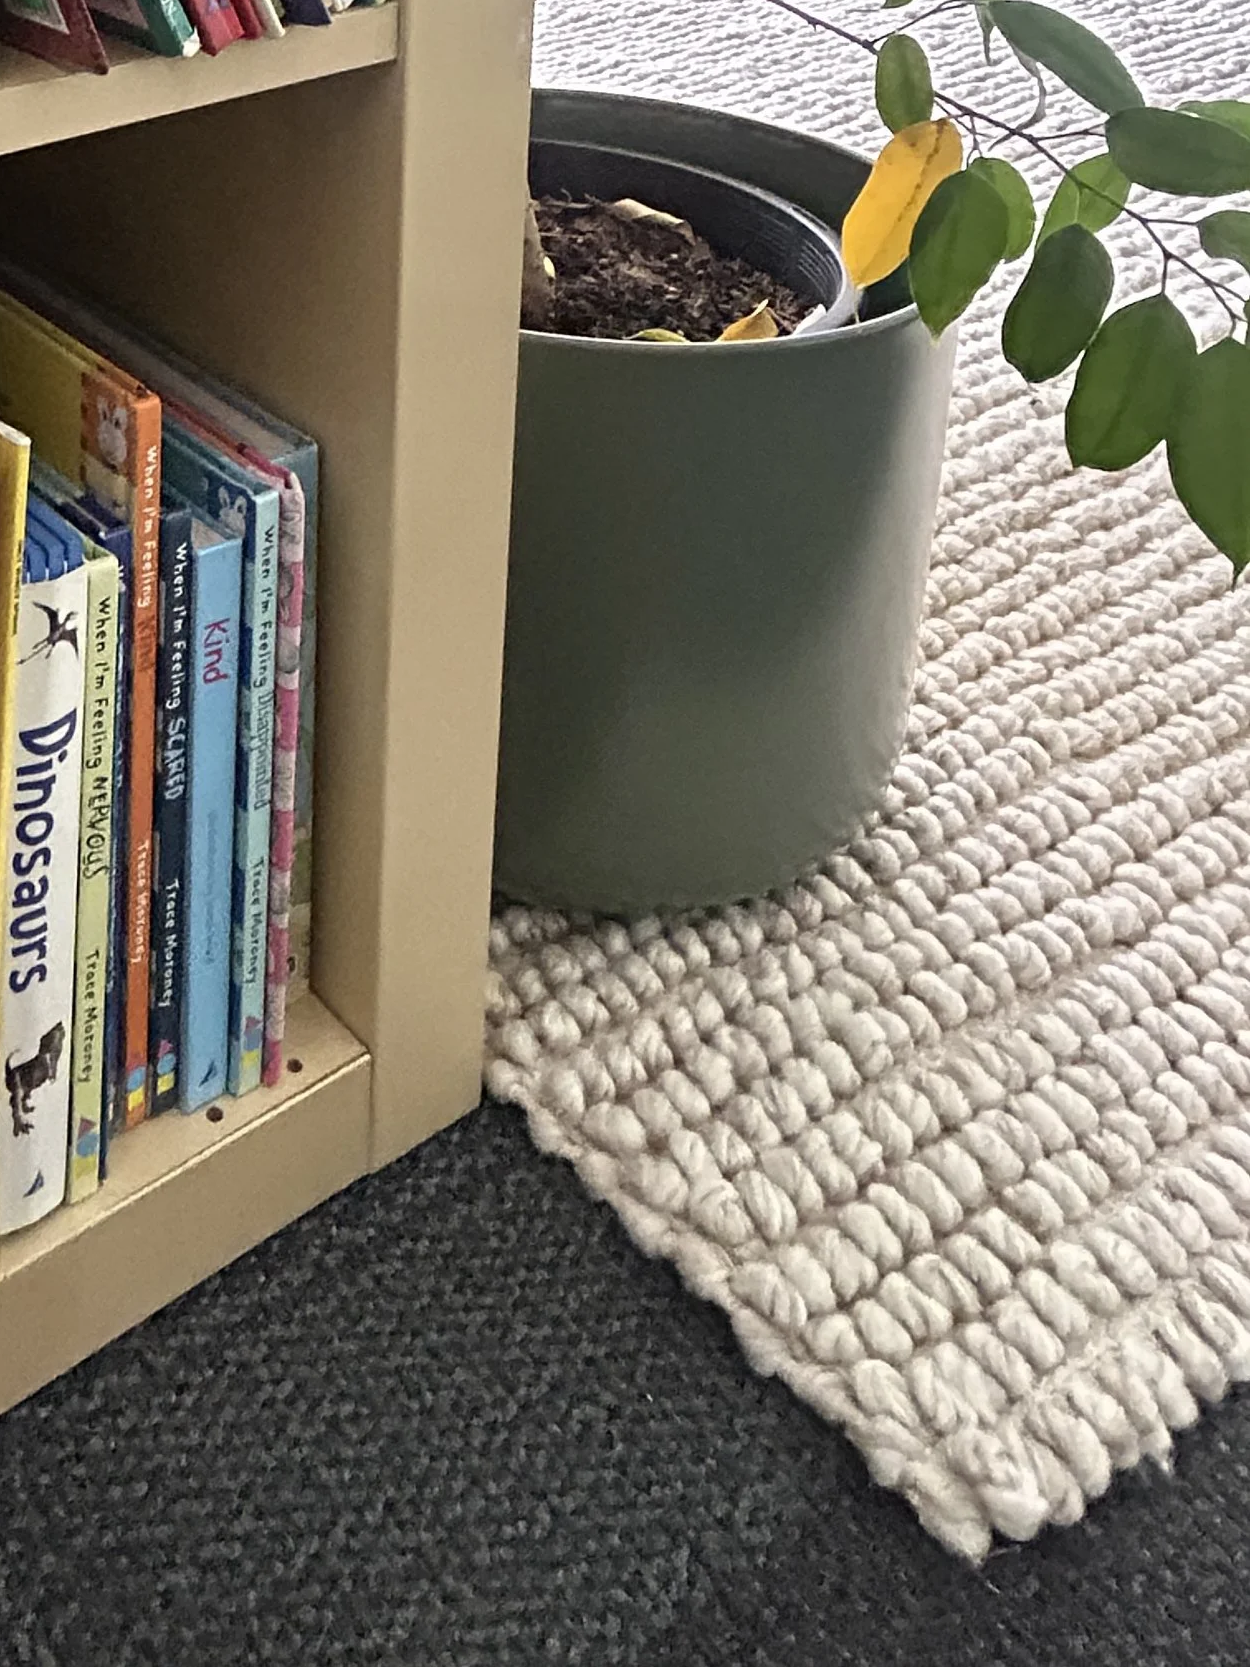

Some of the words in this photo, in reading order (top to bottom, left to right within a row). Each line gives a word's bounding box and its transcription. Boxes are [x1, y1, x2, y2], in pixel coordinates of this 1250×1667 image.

[173, 542, 188, 604] When
[97, 596, 112, 653] When
[173, 607, 186, 634] I'm
[203, 617, 231, 685] Kind
[94, 657, 106, 690] I'm
[166, 637, 187, 710] Feeling
[85, 696, 109, 770] Feeling
[164, 717, 187, 801] SCARED
[8, 707, 77, 995] Dinosaurs
[83, 773, 110, 880] NERVOUS
[165, 879, 180, 929] Trace
[250, 856, 265, 909] Trace
[81, 948, 100, 1002] Trace
[158, 931, 179, 1008] Moroney
[246, 910, 263, 985] Moroney
[76, 1005, 97, 1084] Moroney
